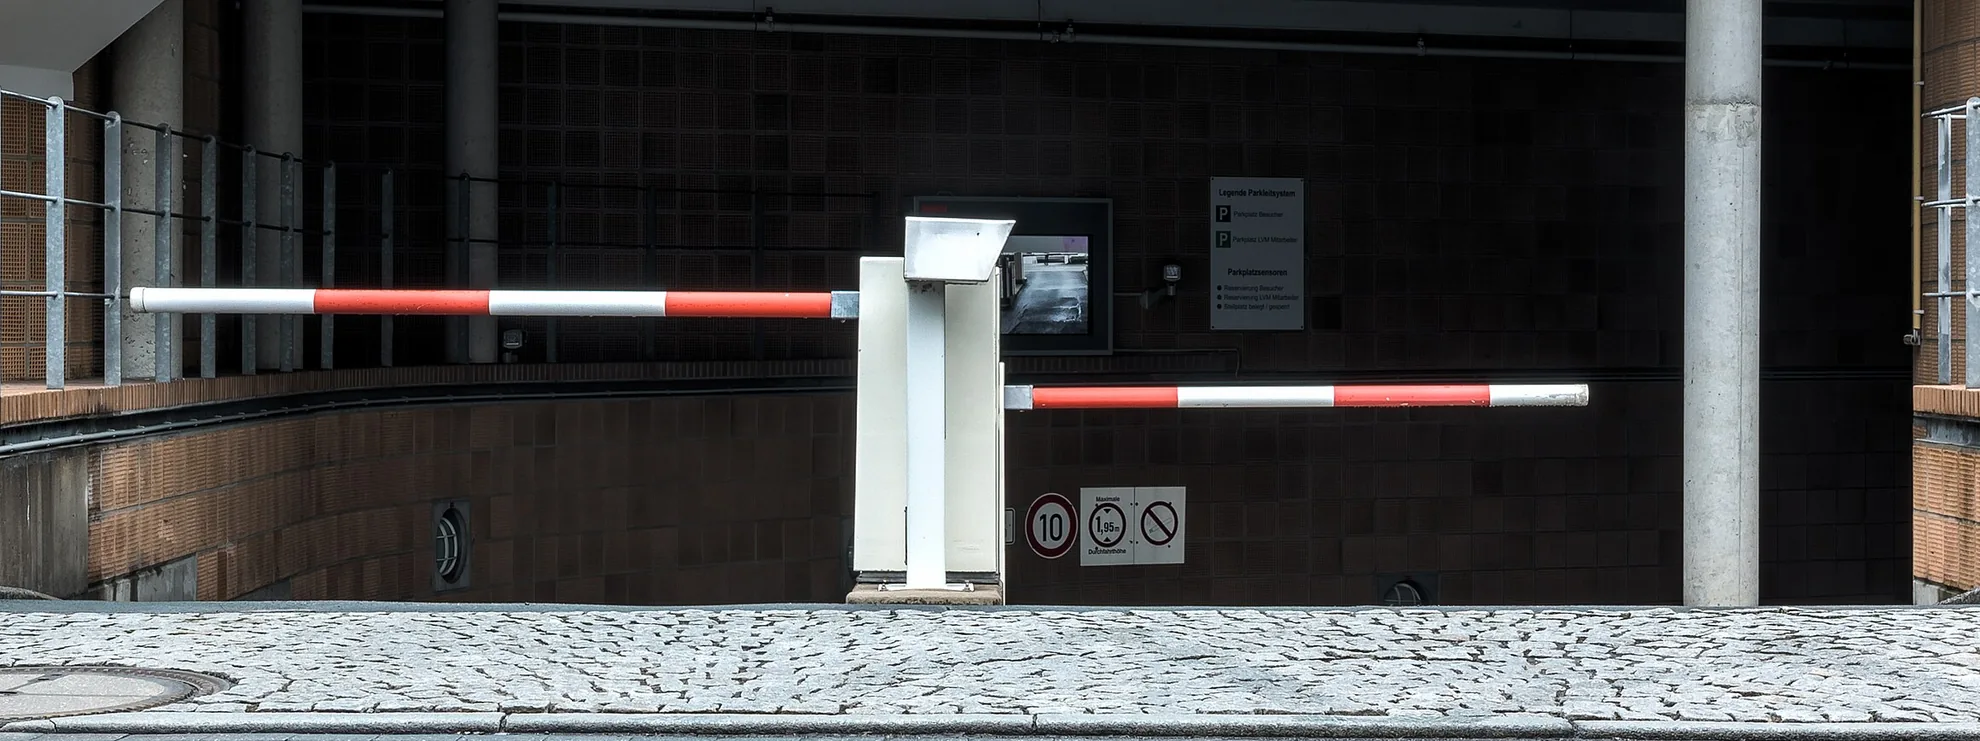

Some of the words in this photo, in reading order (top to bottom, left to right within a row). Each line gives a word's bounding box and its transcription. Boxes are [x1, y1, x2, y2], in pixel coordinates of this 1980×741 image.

[1219, 189, 1247, 198] Legende
[1248, 189, 1296, 198] Parkleitsystem
[1219, 207, 1228, 221] P
[1219, 232, 1228, 247] P
[1227, 268, 1288, 278] Parkplatzsensoren
[1039, 513, 1063, 542] 10
